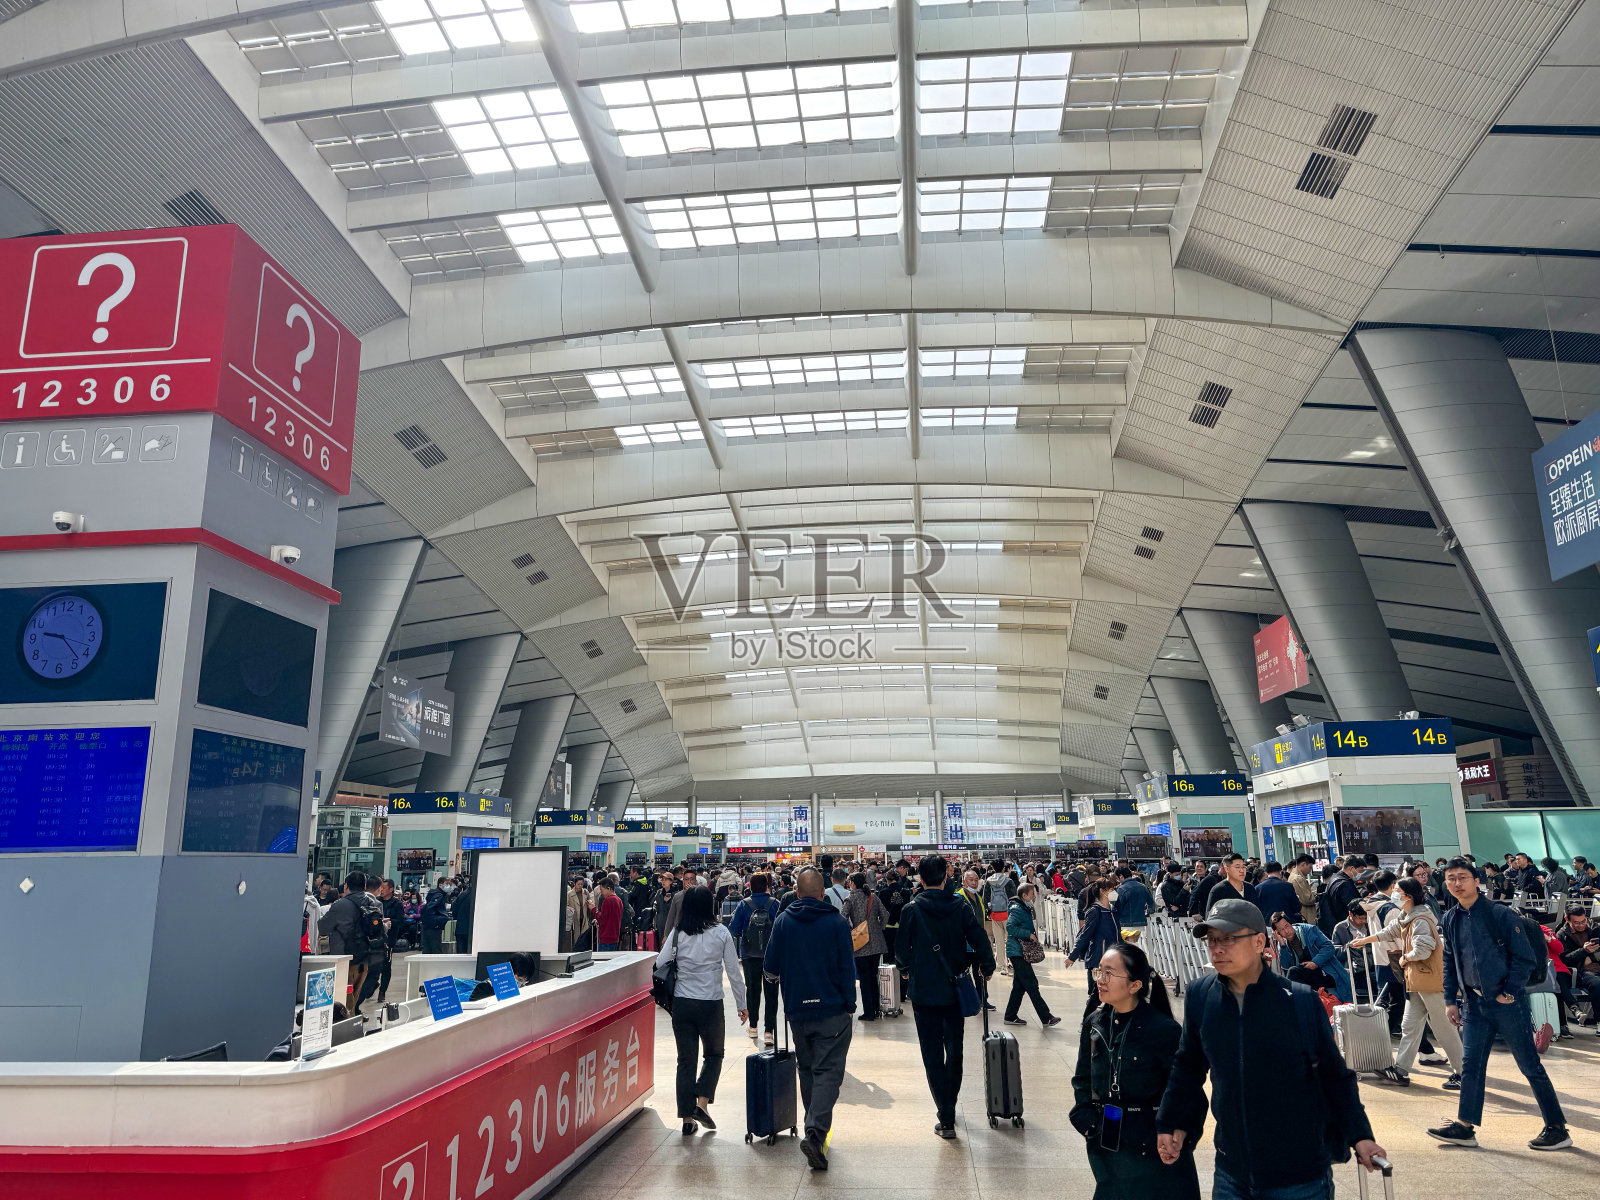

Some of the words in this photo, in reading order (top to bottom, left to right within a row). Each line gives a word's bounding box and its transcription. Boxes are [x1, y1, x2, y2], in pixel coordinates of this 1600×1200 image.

[11, 374, 173, 409] 12306
[247, 395, 330, 472] 12306
[1548, 440, 1594, 480] OPPEIN
[1549, 470, 1595, 518] 至臻生活
[1553, 500, 1600, 546] 欧派厨房
[46, 605, 57, 617] 11
[62, 601, 74, 612] 12
[79, 605, 84, 614] 1
[32, 618, 45, 629] 10
[87, 616, 95, 627] 2
[29, 634, 37, 644] 9
[88, 631, 96, 642] 3
[32, 649, 40, 660] 8
[82, 647, 90, 658] 4
[41, 660, 48, 671] 7
[55, 663, 63, 674] 6
[71, 659, 79, 670] 5
[1311, 732, 1325, 751] 14B
[1332, 729, 1369, 749] 14B
[1411, 727, 1448, 746] 14B
[1465, 764, 1490, 780] 永和大王
[1172, 779, 1195, 792] 16B
[1221, 778, 1243, 791] 16B
[392, 797, 412, 809] 16A
[435, 796, 454, 808] 16A
[1096, 802, 1112, 812] 18B
[539, 814, 553, 823] 18A
[569, 814, 584, 822] 18A
